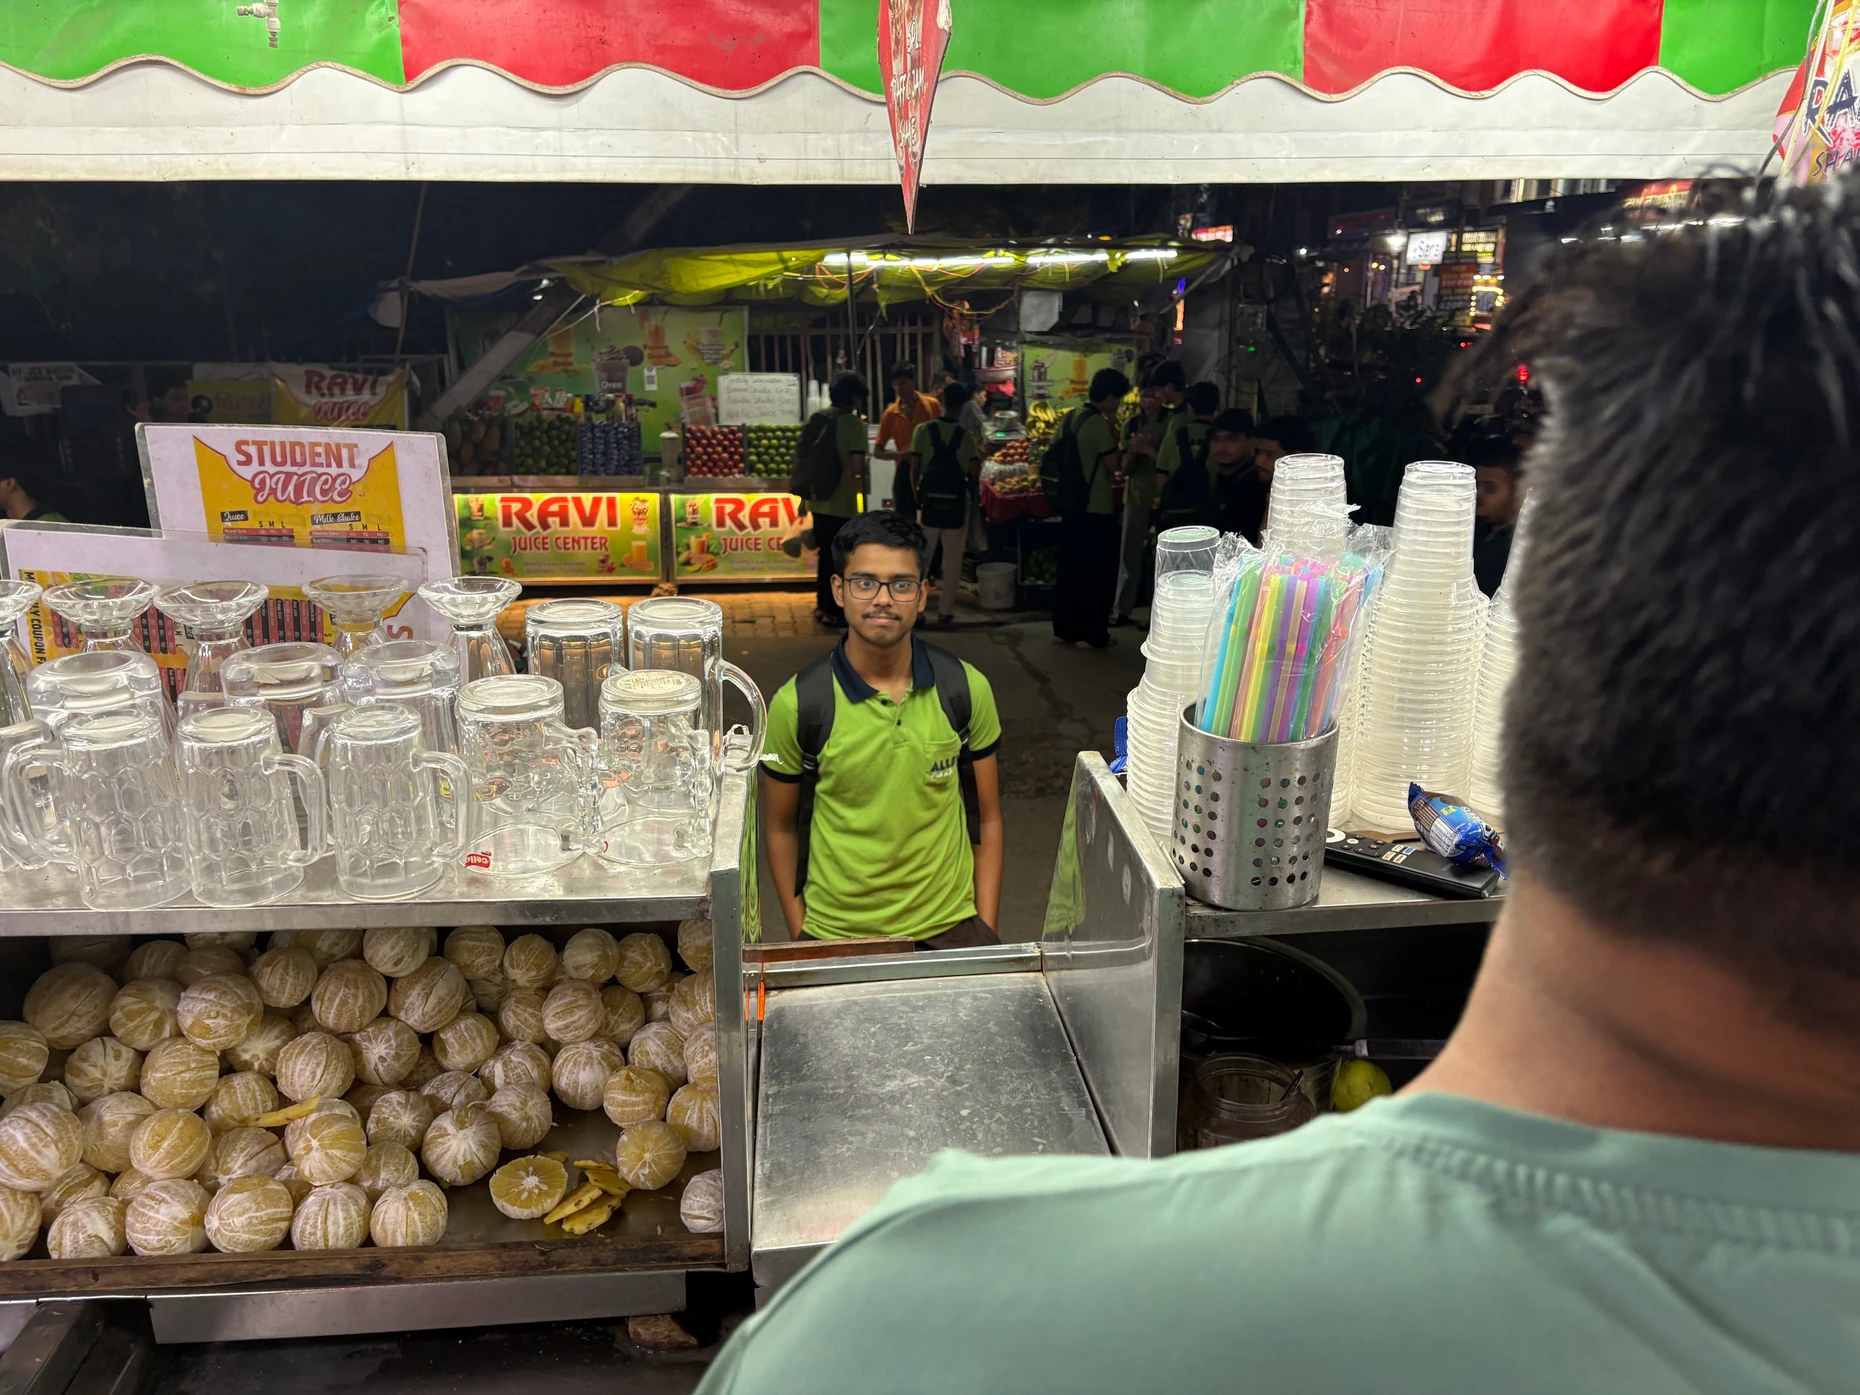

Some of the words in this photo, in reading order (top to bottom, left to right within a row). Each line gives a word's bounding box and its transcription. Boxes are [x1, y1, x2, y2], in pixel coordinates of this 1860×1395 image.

[304, 369, 379, 398] RAVI
[313, 401, 371, 422] JUICE
[235, 440, 358, 469] STUDENT
[252, 471, 352, 504] JUICE
[314, 513, 335, 523] Milk
[336, 512, 361, 523] Shake
[499, 495, 619, 532] RAVI
[511, 535, 550, 555] JUICE
[554, 535, 609, 553] CENTER
[721, 537, 763, 555] JUICE
[31, 618, 46, 654] COUPON
